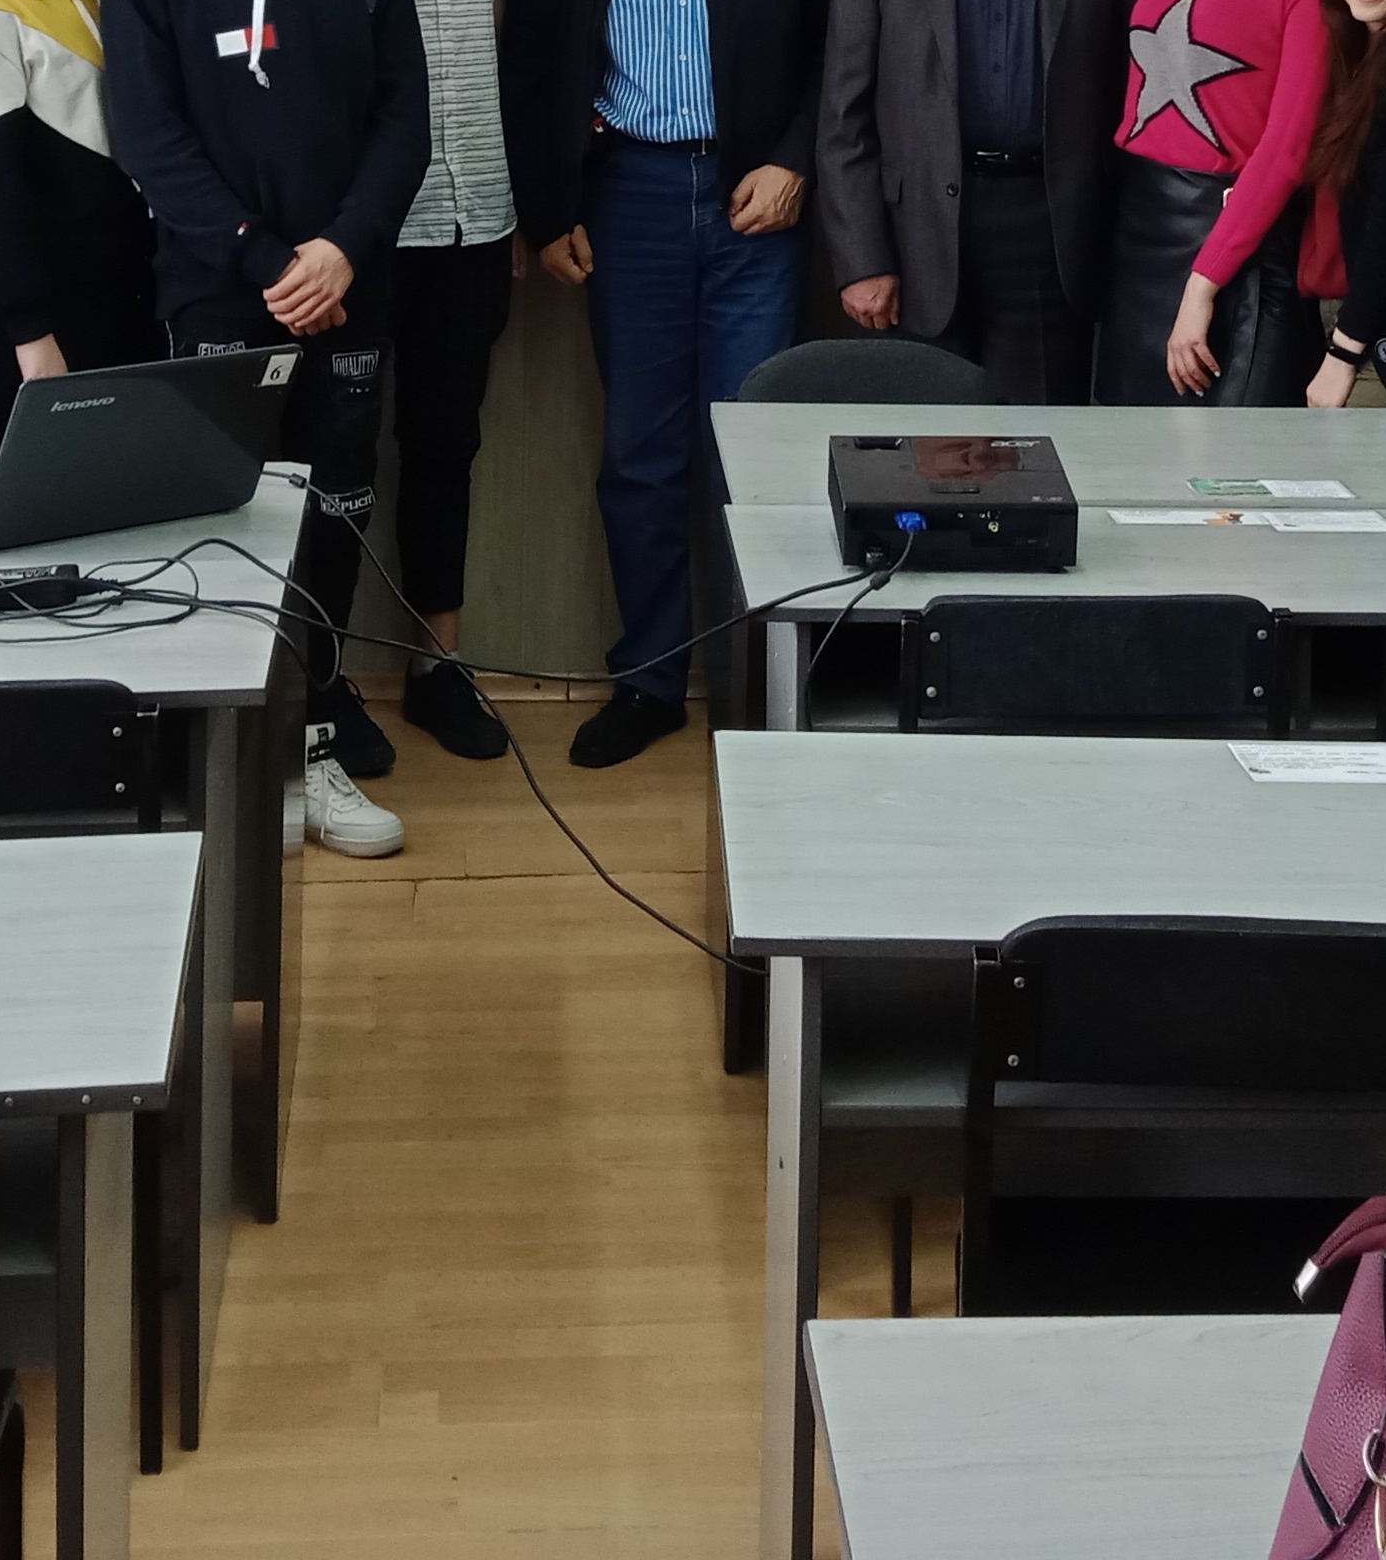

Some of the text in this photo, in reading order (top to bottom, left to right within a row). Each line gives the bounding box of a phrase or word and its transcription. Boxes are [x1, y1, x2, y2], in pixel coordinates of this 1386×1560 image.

[269, 364, 284, 381] 6
[50, 396, 116, 413] lenovo
[990, 440, 1041, 448] acer
